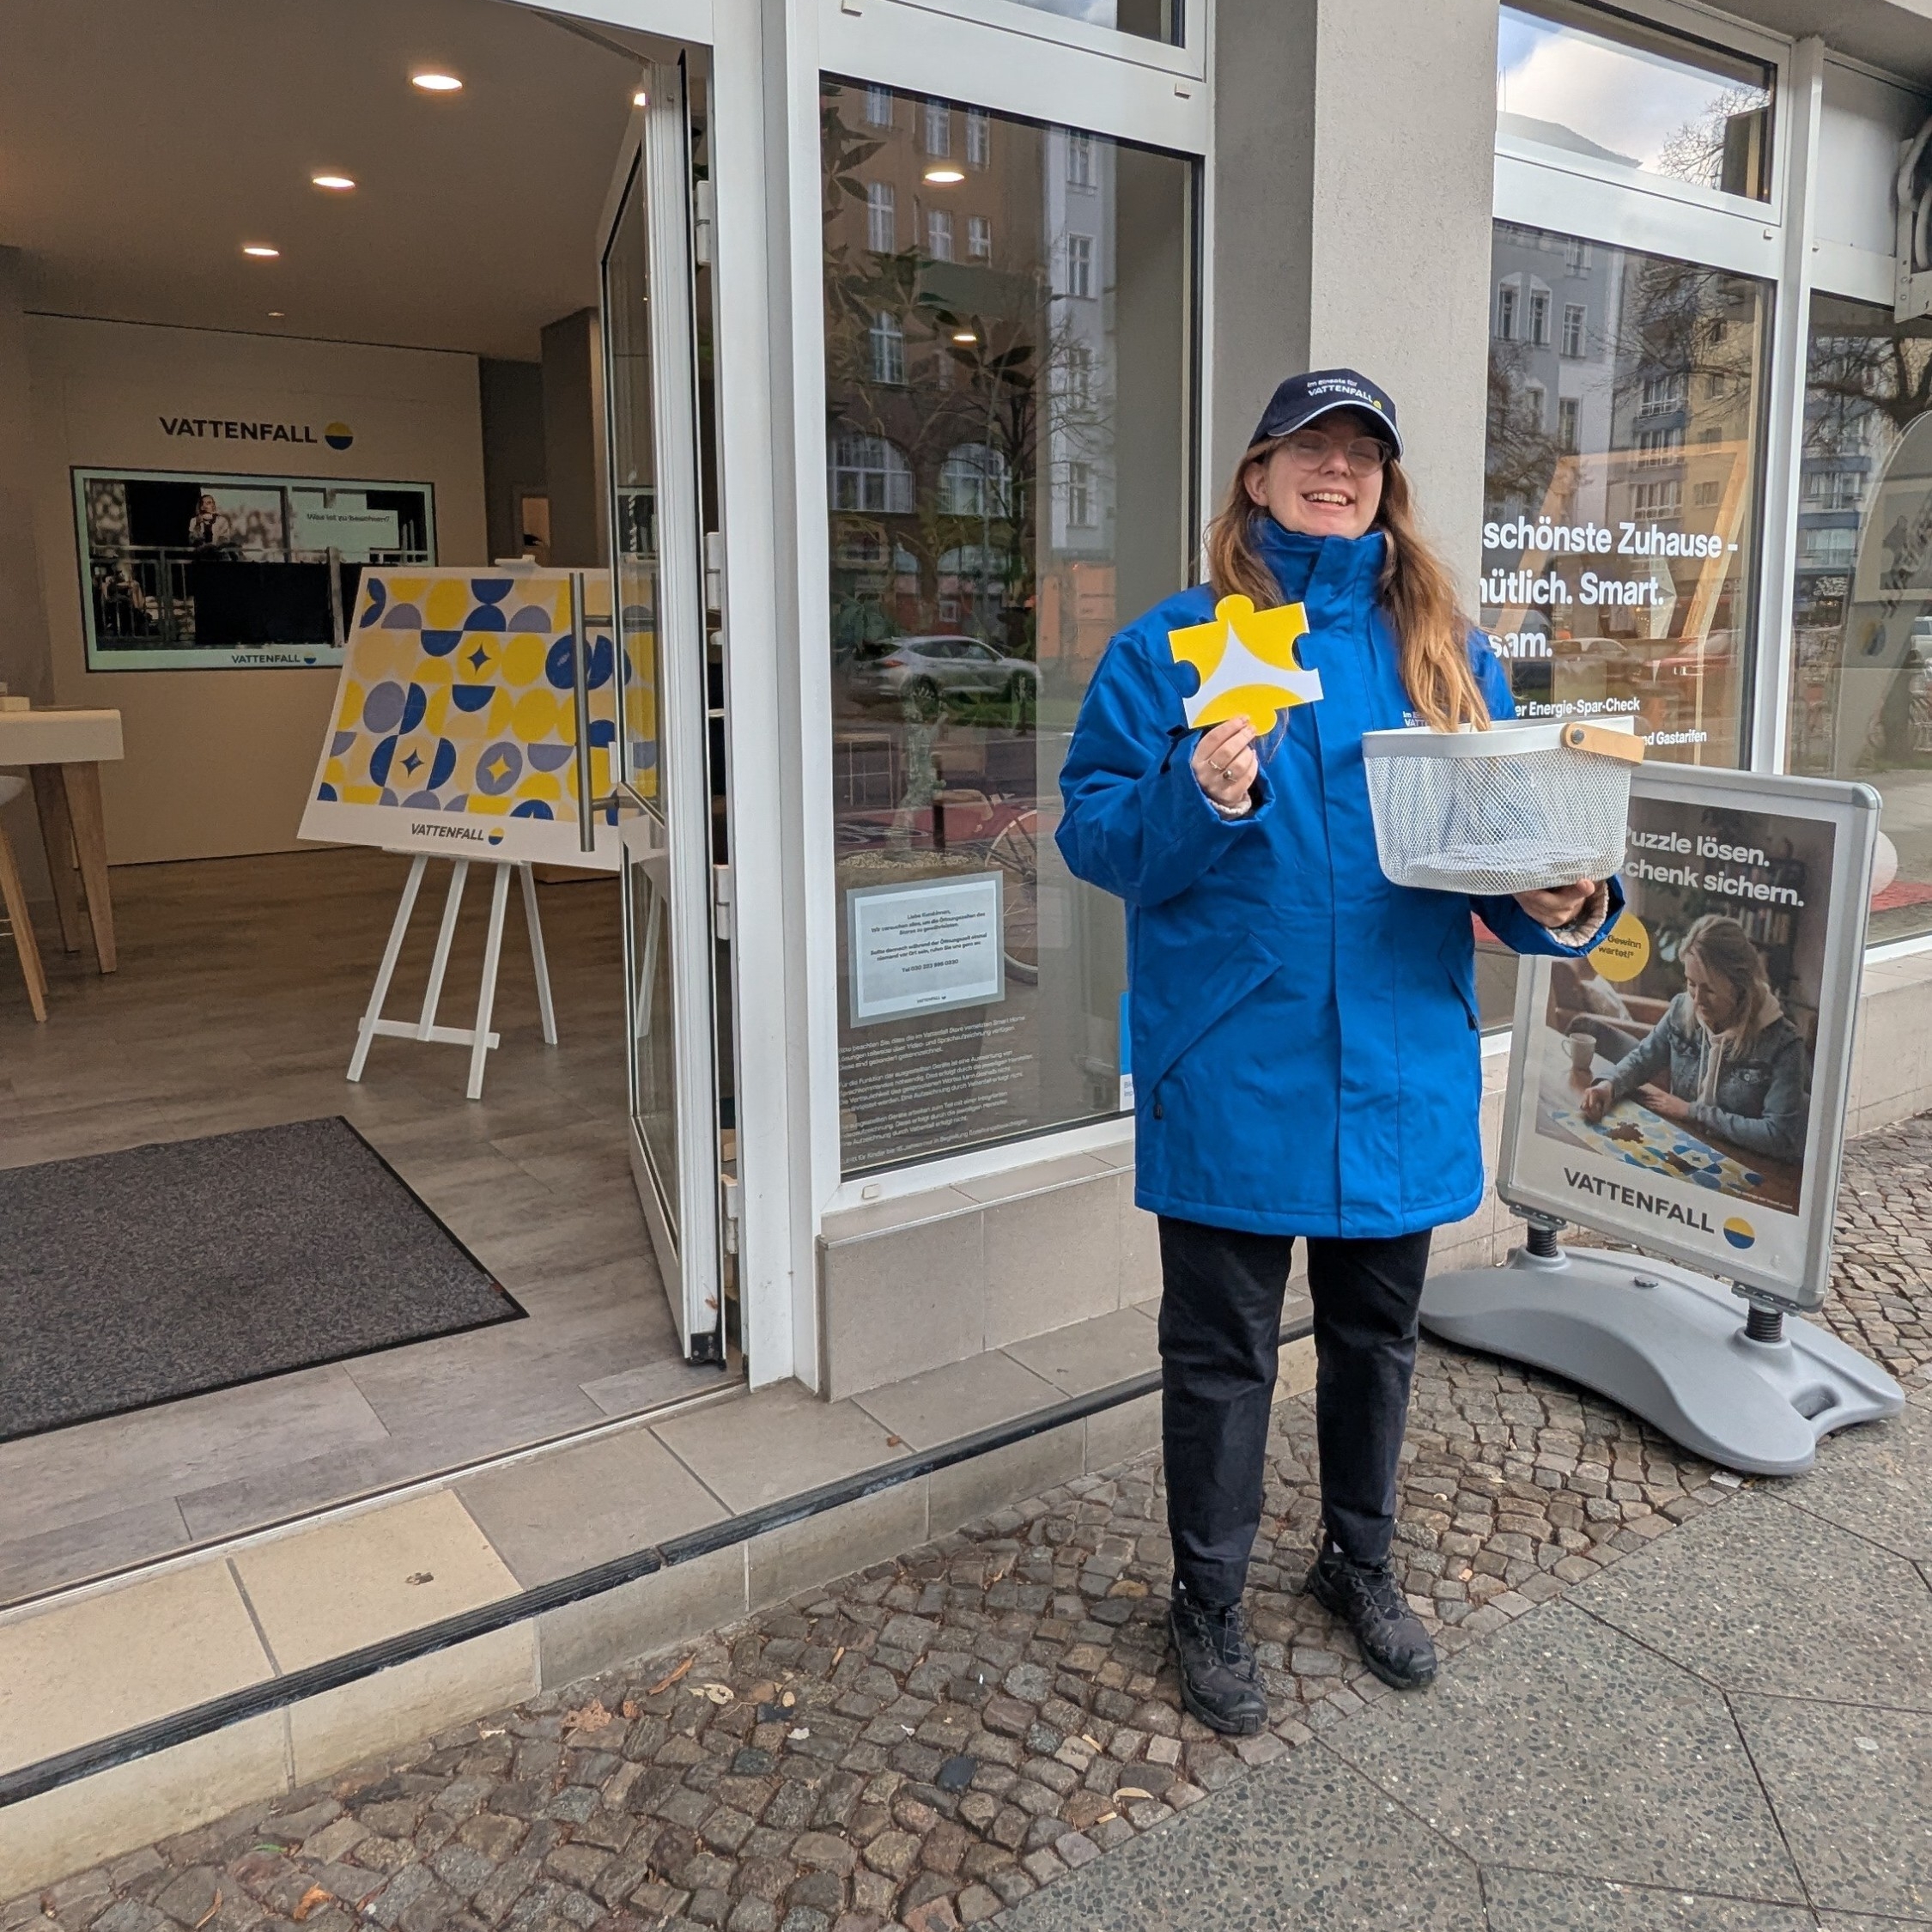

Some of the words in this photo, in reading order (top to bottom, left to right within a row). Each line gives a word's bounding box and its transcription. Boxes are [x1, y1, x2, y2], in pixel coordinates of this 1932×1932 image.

[1308, 385, 1374, 404] VATTENFALL
[159, 416, 318, 444] VATTENFALL
[1483, 515, 1613, 554] schönste
[1618, 521, 1722, 558] Zuhause
[1579, 571, 1665, 606] Smart.
[231, 654, 301, 664] VATTENFALL
[1528, 697, 1641, 719] Energie-Spar-Check
[1656, 729, 1708, 745] Gastarifen
[411, 823, 484, 841] VATTENFALL
[1696, 835, 1771, 868] lösen.
[1620, 858, 1699, 889] chenk
[1703, 871, 1805, 908] sichern.
[1564, 1167, 1716, 1235] VATTENFALL
